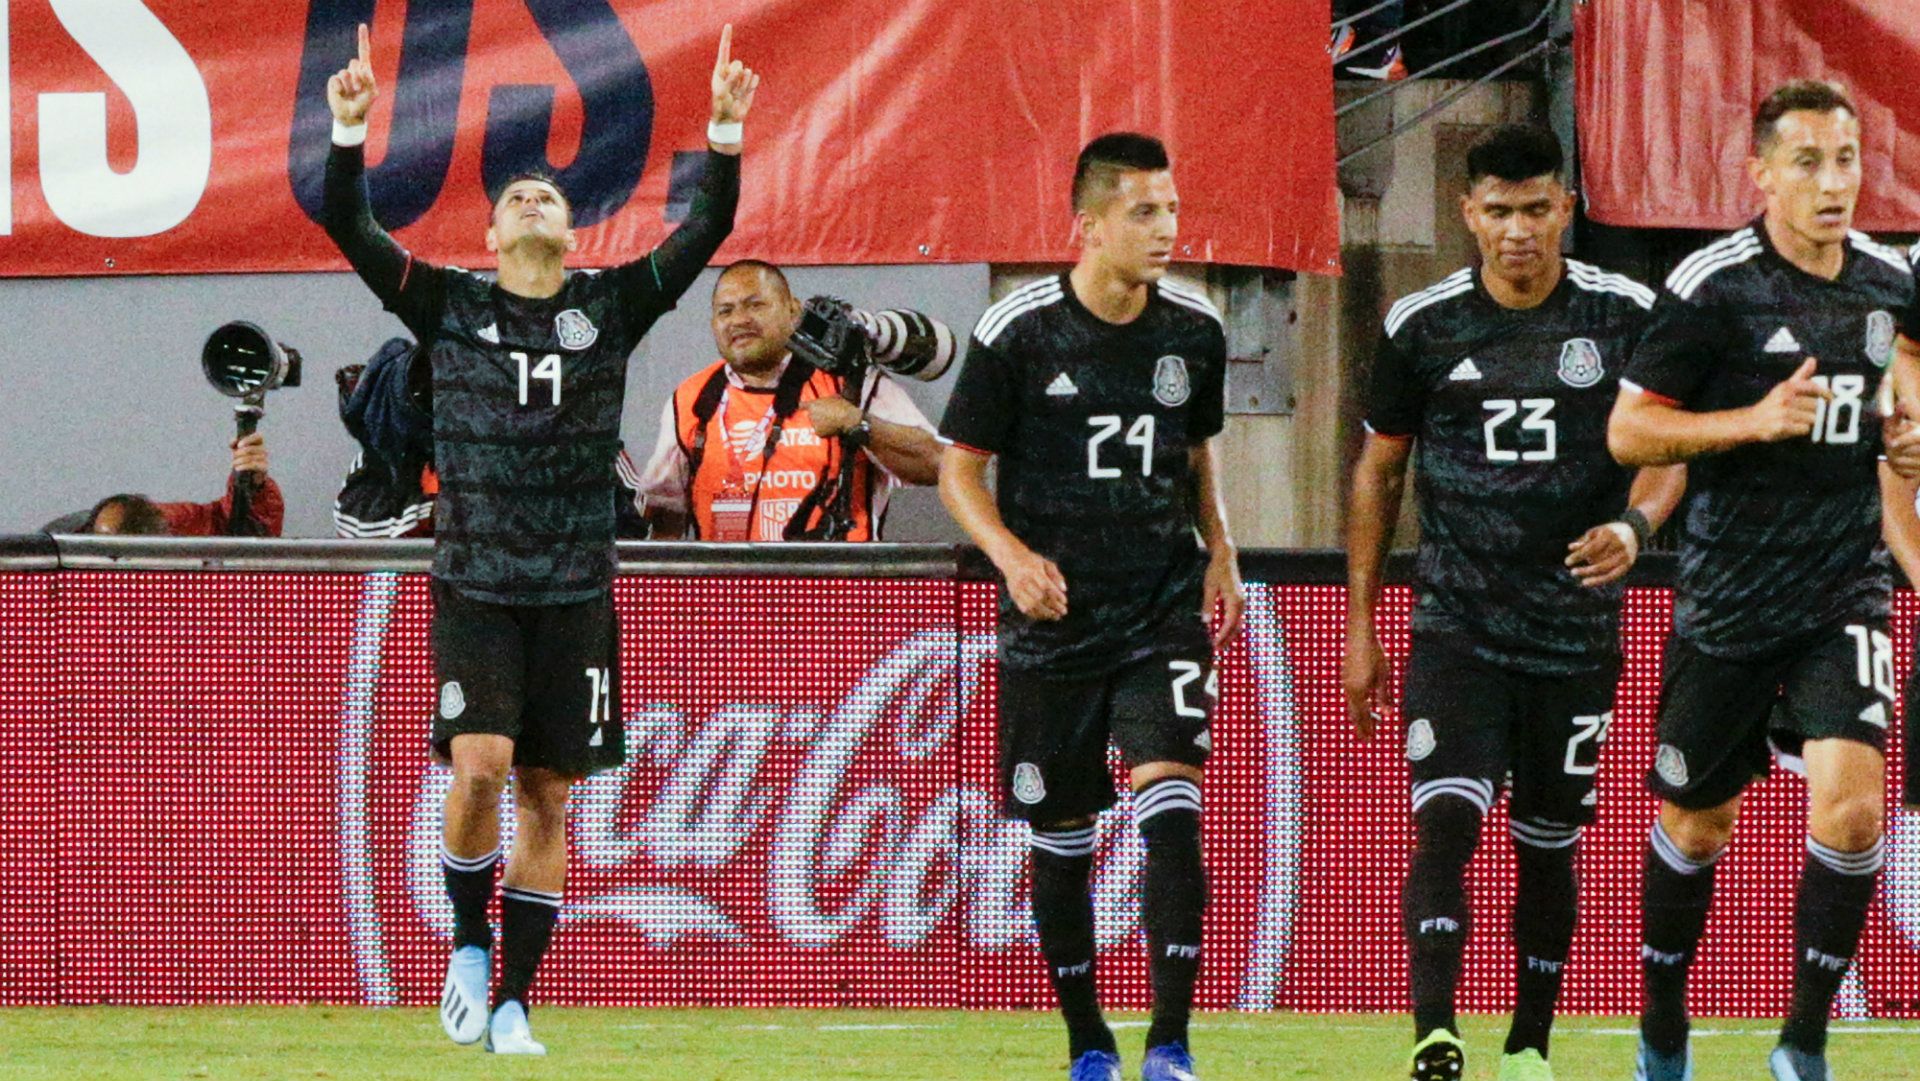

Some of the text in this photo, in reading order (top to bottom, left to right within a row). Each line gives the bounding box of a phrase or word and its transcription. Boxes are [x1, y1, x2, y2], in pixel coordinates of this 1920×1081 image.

[0, 0, 213, 238] S
[509, 351, 562, 406] 14
[1810, 374, 1864, 444] 18
[1087, 414, 1156, 479] 24
[1482, 398, 1556, 461] 23
[743, 469, 817, 489] PHOTO
[1844, 624, 1897, 701] 18
[585, 667, 610, 723] 14
[1420, 916, 1459, 934] FMF
